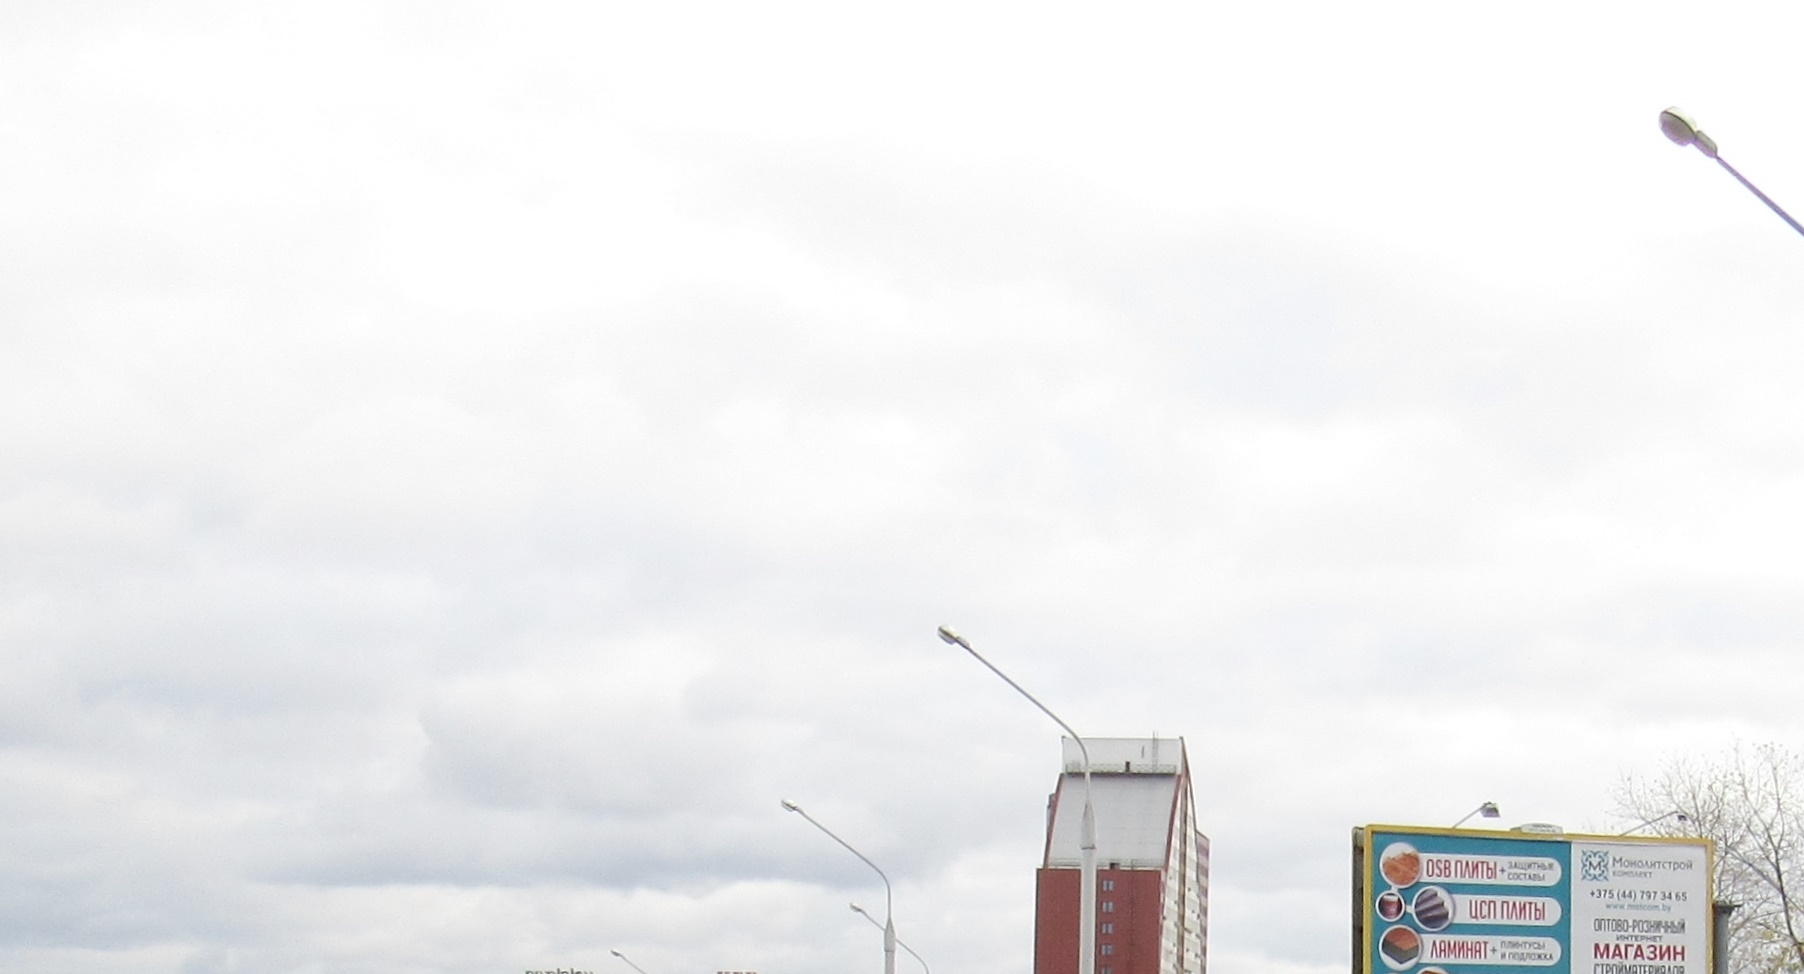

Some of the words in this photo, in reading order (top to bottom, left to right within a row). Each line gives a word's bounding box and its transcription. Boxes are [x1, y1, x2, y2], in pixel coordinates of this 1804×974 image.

[1426, 859, 1451, 878] OSB
[1454, 861, 1497, 879] ПЛИТЫ
[1508, 861, 1554, 871] ЗАЩИТНЫЕ
[1612, 856, 1693, 871] Монолитстрой
[1508, 872, 1545, 881] СОСТАВЫ
[1590, 889, 1614, 899] +375
[1617, 889, 1637, 902] (44)
[1640, 891, 1657, 900] 797
[1661, 891, 1672, 901] 34
[1675, 892, 1687, 901] 65
[1469, 900, 1496, 920] ЦСП
[1501, 901, 1545, 920] ПЛИТЫ
[1593, 918, 1685, 934] ОПТОВО-РОЗНИЧНЫЙ
[1616, 934, 1663, 942] ИНТЕРНЕТ
[1430, 940, 1488, 959] ЛАМИНАТ
[1501, 941, 1545, 950] ПЛИНТУСЫ
[1594, 943, 1685, 961] МАГАЗИН
[1508, 952, 1553, 961] ПОДЛОЖКА
